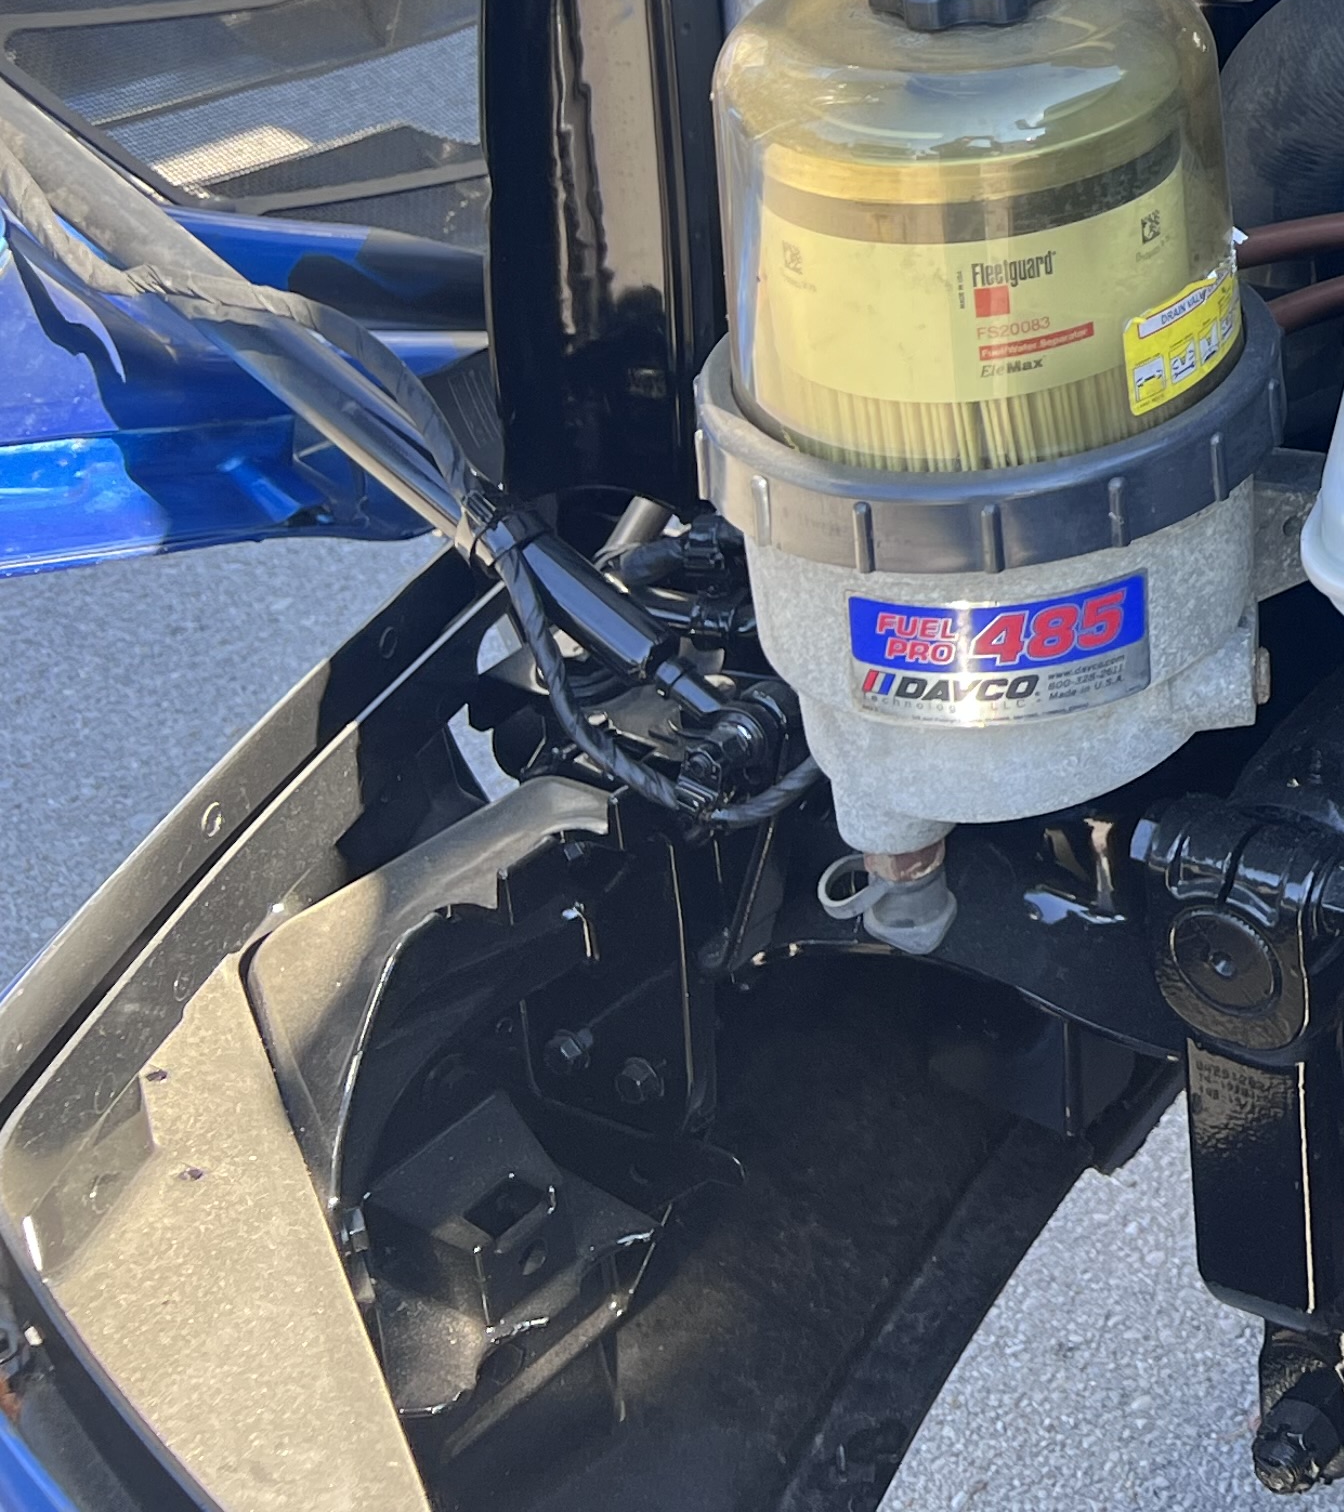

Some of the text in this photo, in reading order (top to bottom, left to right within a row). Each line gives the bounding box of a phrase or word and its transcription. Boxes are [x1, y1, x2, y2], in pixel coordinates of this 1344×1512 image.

[971, 251, 1053, 288] Fleetguard
[977, 316, 1051, 339] FS20083
[1160, 305, 1186, 325] DRAIN
[981, 328, 1088, 357] Fuel/Water Separator
[980, 359, 1043, 378] EleMax
[876, 588, 1127, 667] FUEL 485
[884, 638, 957, 665] PRO
[1048, 654, 1126, 680] www.davco.com
[896, 674, 1039, 701] DAVCO
[1048, 687, 1077, 700] Made
